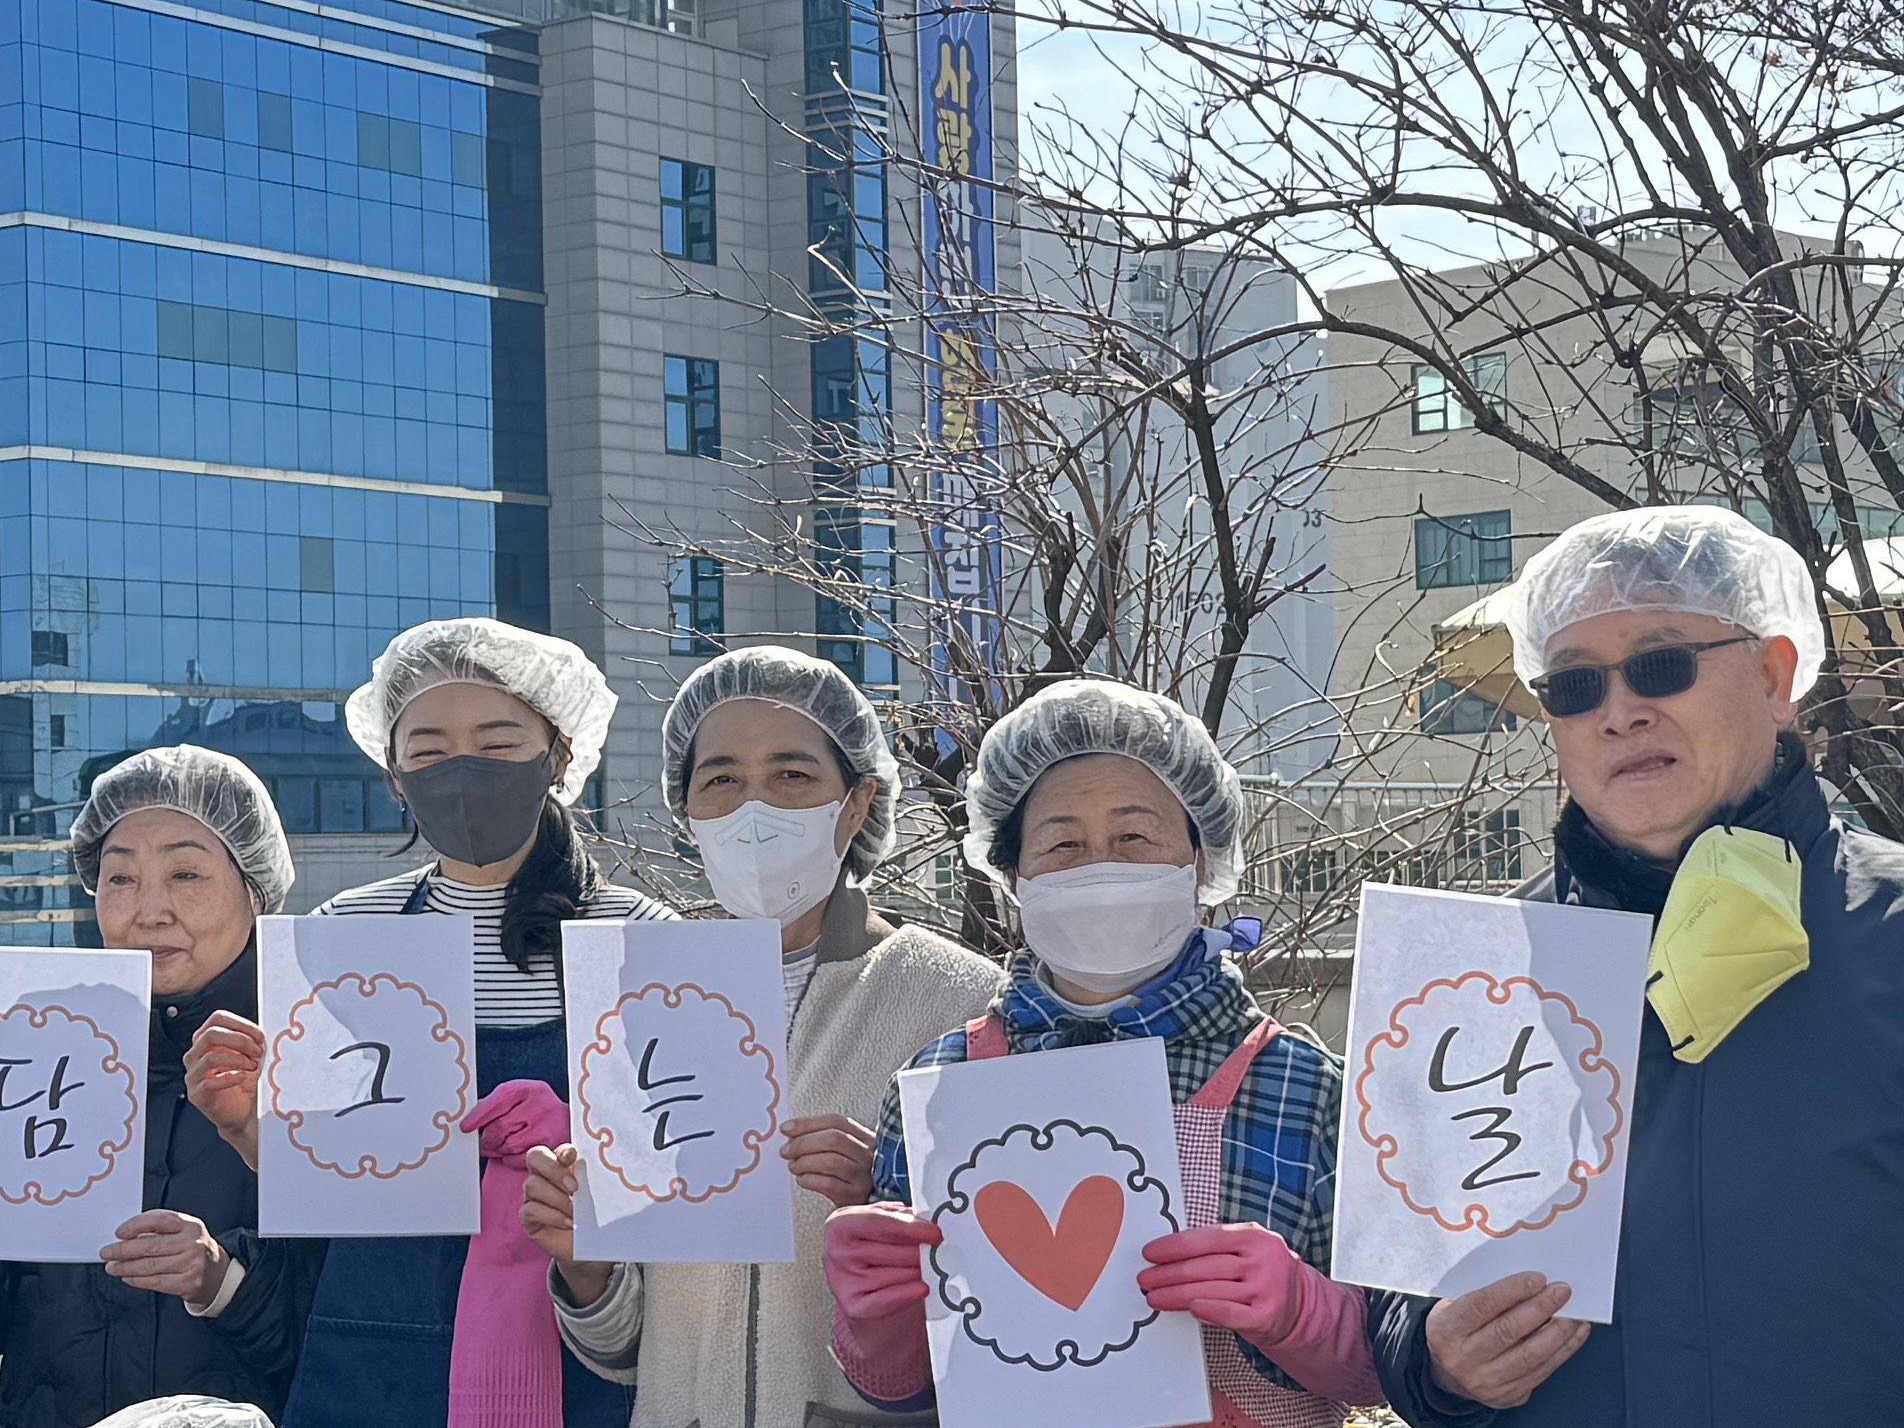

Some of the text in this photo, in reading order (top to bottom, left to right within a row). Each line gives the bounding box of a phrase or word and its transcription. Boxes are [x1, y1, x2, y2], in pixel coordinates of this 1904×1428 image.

[329, 1041, 406, 1118] 그
[637, 1037, 715, 1151] 는
[1428, 1025, 1554, 1190] 날
